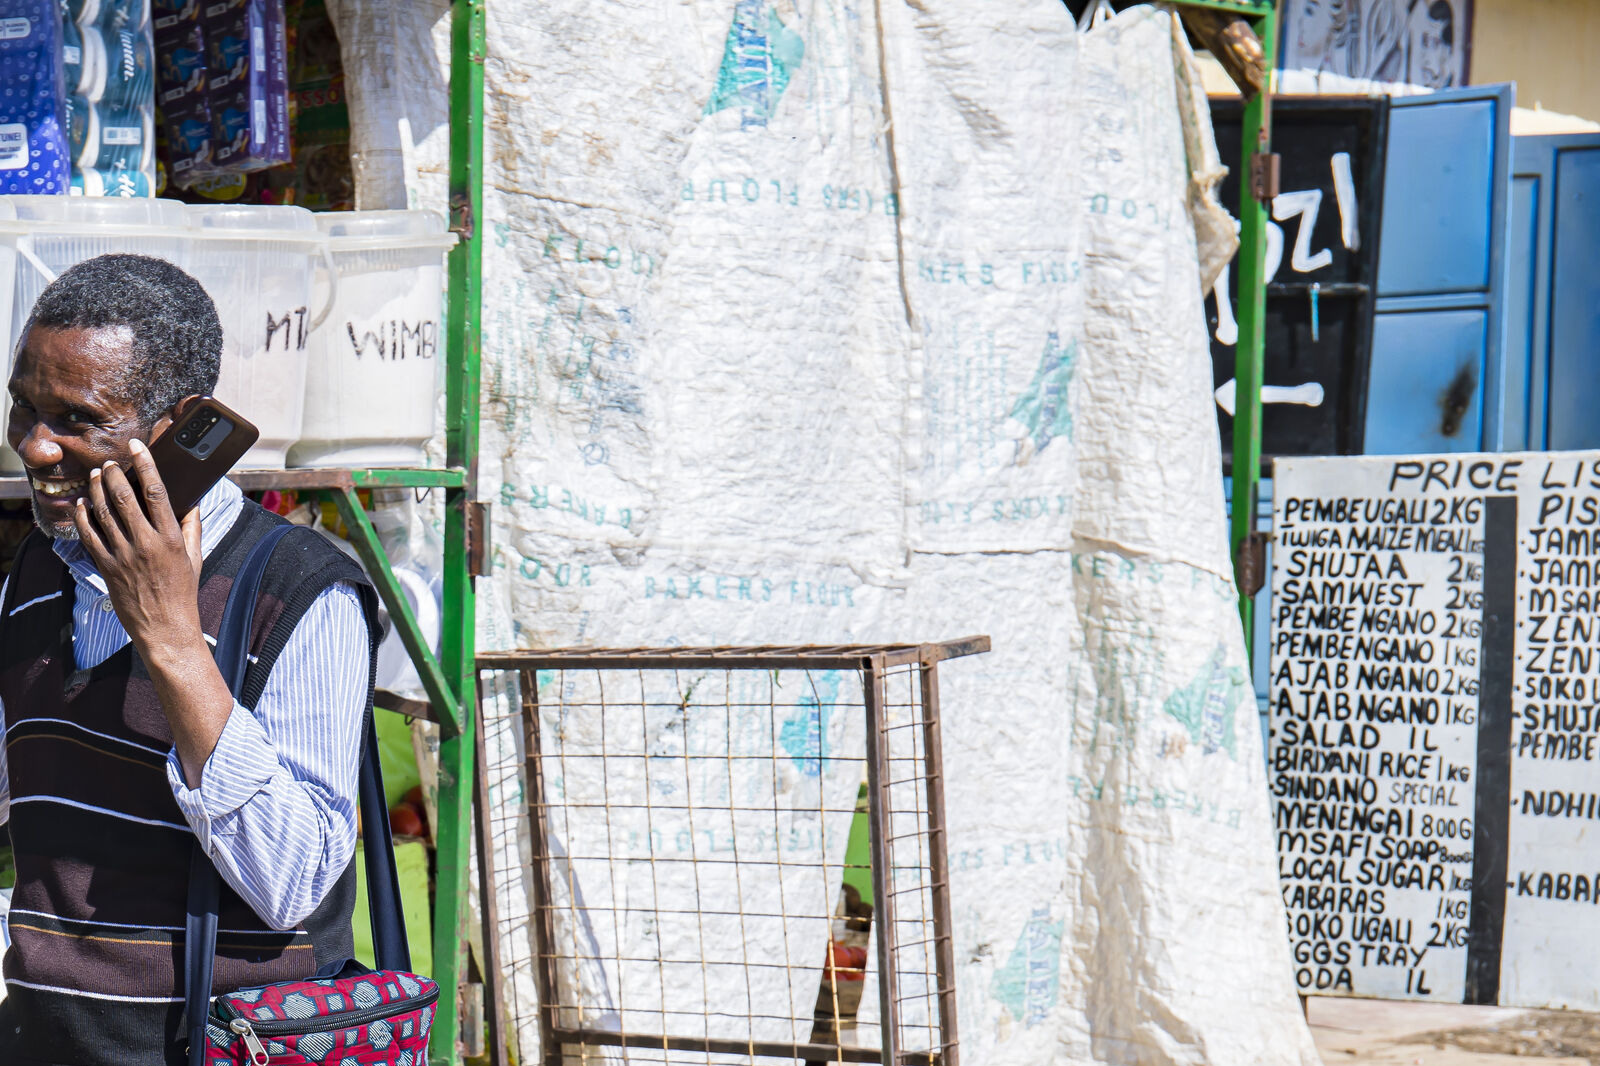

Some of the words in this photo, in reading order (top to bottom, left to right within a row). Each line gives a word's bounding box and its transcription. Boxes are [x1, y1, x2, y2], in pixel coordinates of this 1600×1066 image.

[1389, 460, 1524, 493] PRICE
[1287, 550, 1408, 580] SHUJAA
[1278, 605, 1356, 632] PEMBE
[1359, 608, 1436, 635] NGANO
[1277, 631, 1355, 659] PEMBE
[1355, 636, 1434, 664] NGANO
[1275, 659, 1349, 690] AJAB
[1356, 664, 1439, 693] NGANO
[1525, 676, 1587, 701] SOKO
[1276, 688, 1351, 722] AJAB
[1356, 694, 1439, 724] NGANO
[1281, 720, 1381, 750] SALAD
[1518, 731, 1597, 761] PEMBE
[1379, 751, 1433, 780] RICE
[1273, 774, 1378, 805] SINDANO
[1389, 782, 1459, 806] SPECIAL
[1276, 802, 1413, 838] MENENGAI
[1421, 814, 1473, 841] 800G
[1279, 856, 1352, 884] LOCAL
[1356, 859, 1445, 891] SUGAR
[1351, 914, 1413, 944] UGALI
[1359, 944, 1428, 967] TRAY
